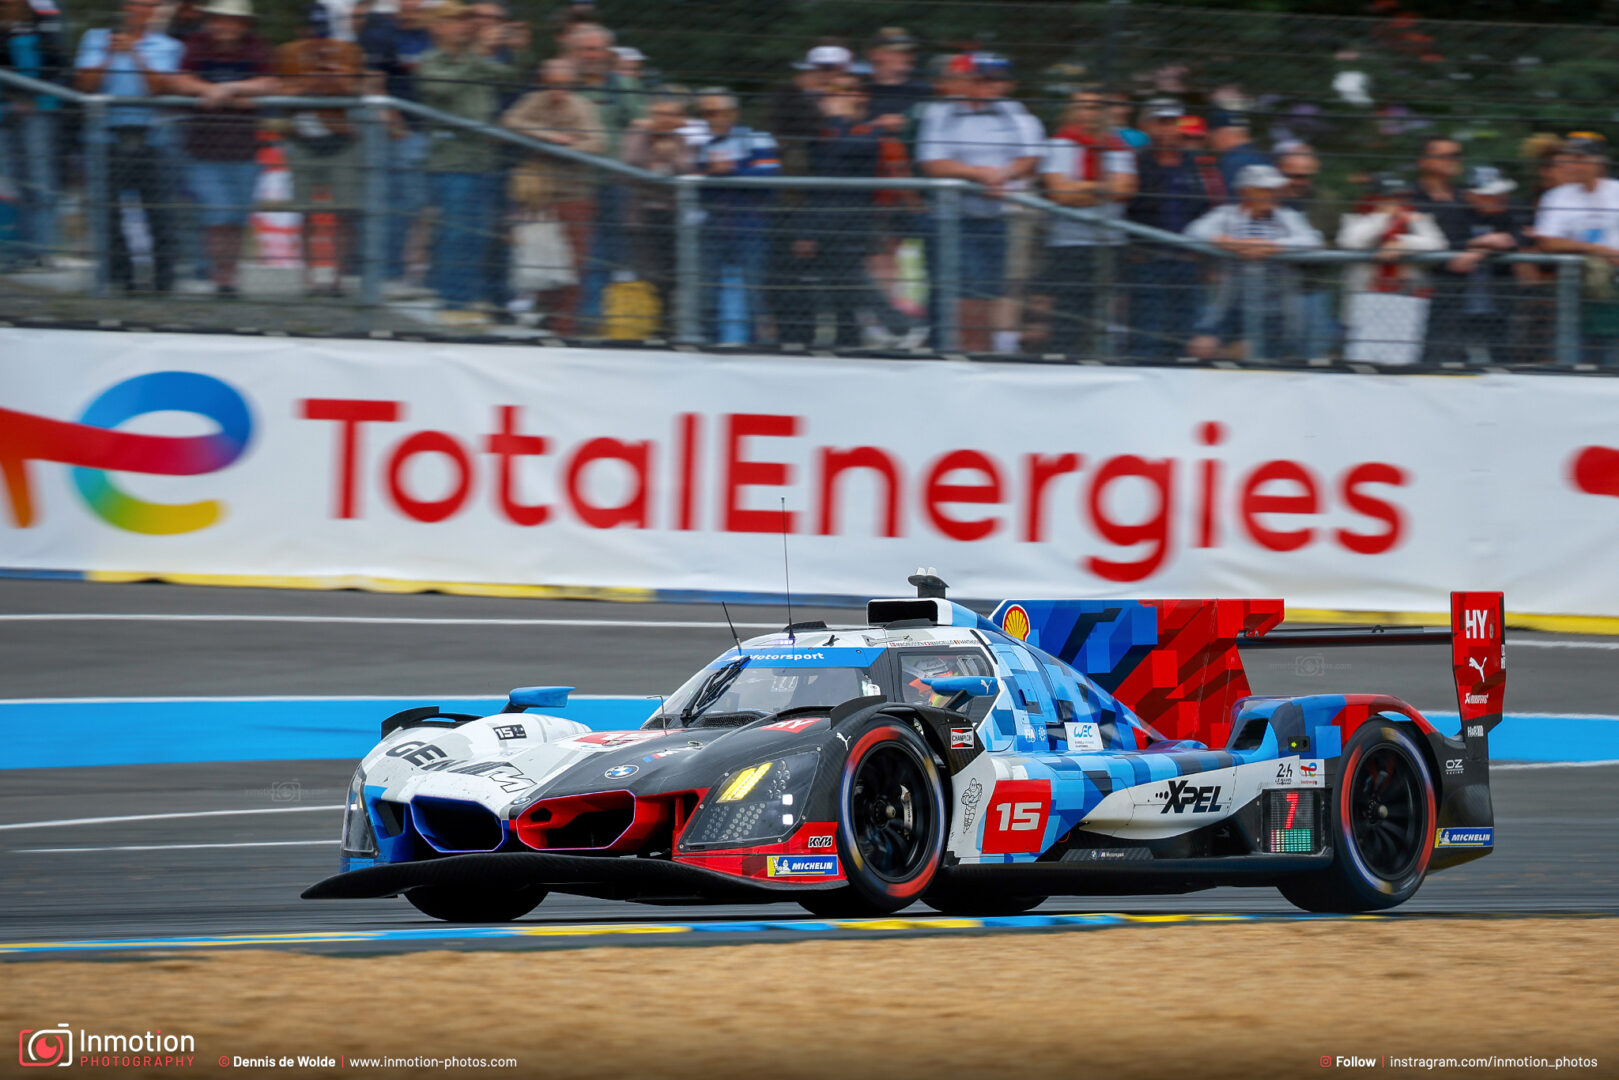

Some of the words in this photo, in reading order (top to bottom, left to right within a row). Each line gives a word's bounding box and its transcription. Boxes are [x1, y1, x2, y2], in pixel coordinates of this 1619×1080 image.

[299, 398, 1409, 582] TotalEnergies
[1465, 609, 1488, 638] HY
[494, 727, 514, 739] 15
[1074, 725, 1093, 738] WEC
[1445, 759, 1463, 770] OZ
[1161, 780, 1222, 814] XPEL
[996, 802, 1042, 831] 15
[1285, 792, 1299, 829] 7
[808, 836, 833, 848] KYB
[792, 862, 833, 871] MICHELIN
